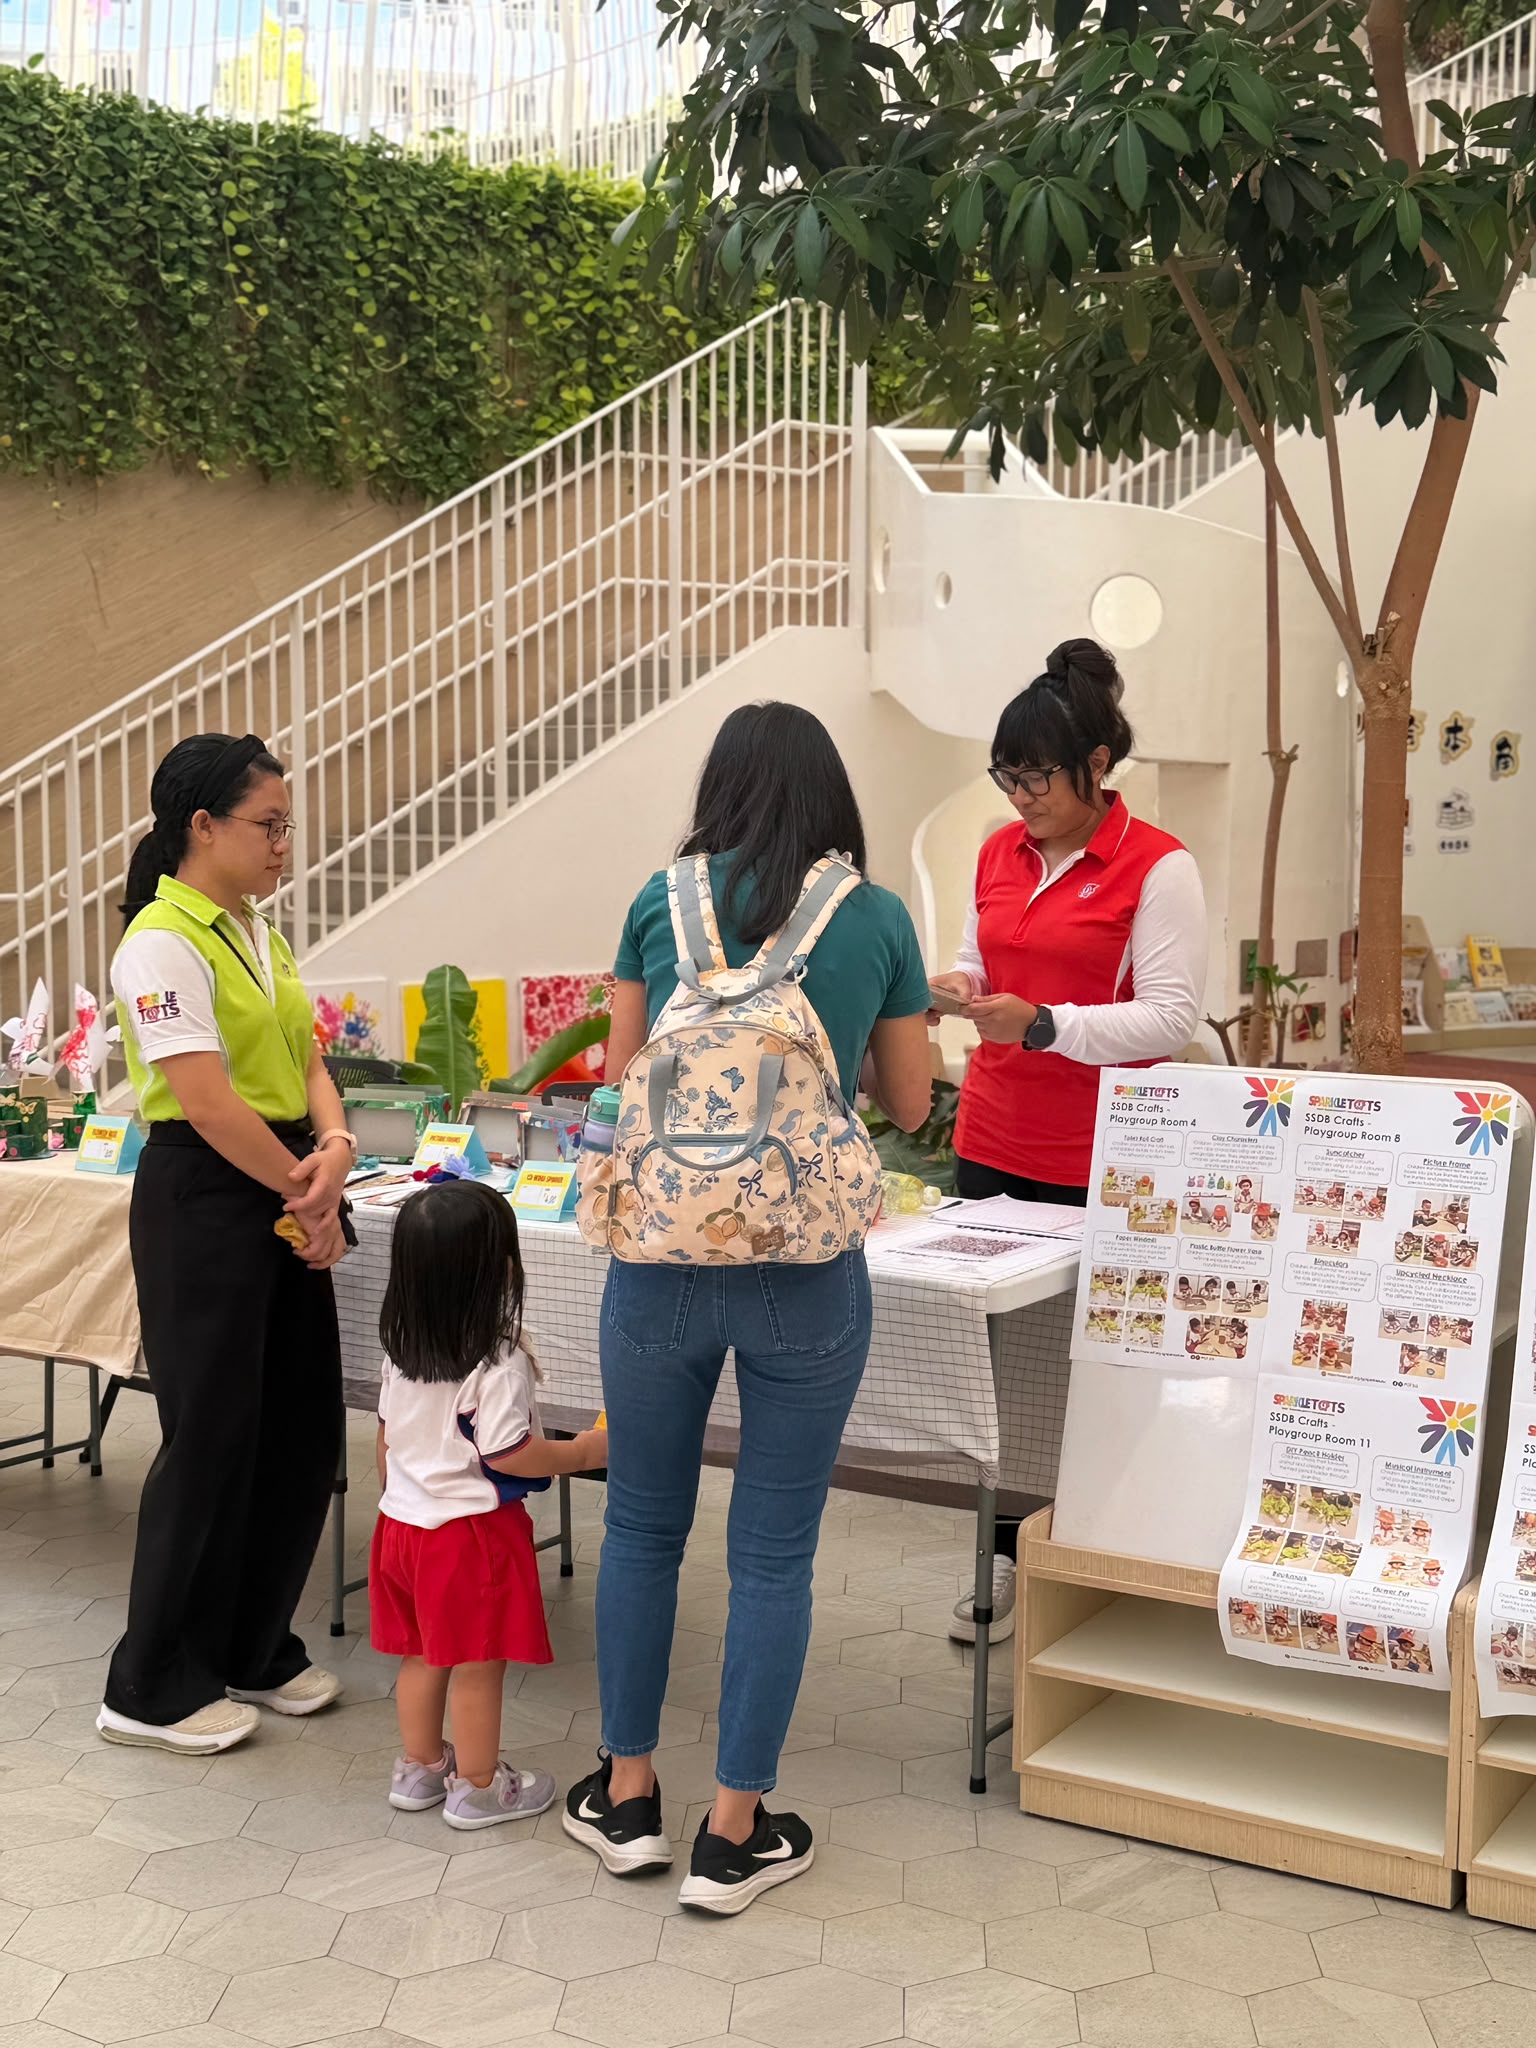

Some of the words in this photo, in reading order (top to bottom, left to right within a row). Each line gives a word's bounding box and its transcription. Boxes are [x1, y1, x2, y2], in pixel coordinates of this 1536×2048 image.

[1111, 1102, 1133, 1111] SSDB
[1137, 1104, 1163, 1113] Crafts
[1110, 1115, 1158, 1126] Playgroup
[1161, 1117, 1188, 1126] Room
[1305, 1113, 1330, 1124] SSDB
[1334, 1116, 1364, 1126] Crafts
[1304, 1126, 1358, 1140] Playgroup
[1361, 1132, 1391, 1142] Room
[1394, 1134, 1400, 1142] 8
[1423, 1159, 1447, 1167] Picture
[1432, 1273, 1467, 1284] Necklace
[1270, 1411, 1295, 1424] SSDB
[1298, 1416, 1328, 1429] Crafts
[1269, 1426, 1322, 1443] Playgroup
[1326, 1434, 1356, 1447] Room
[1360, 1438, 1371, 1448] 11
[1385, 1461, 1413, 1472] Musical
